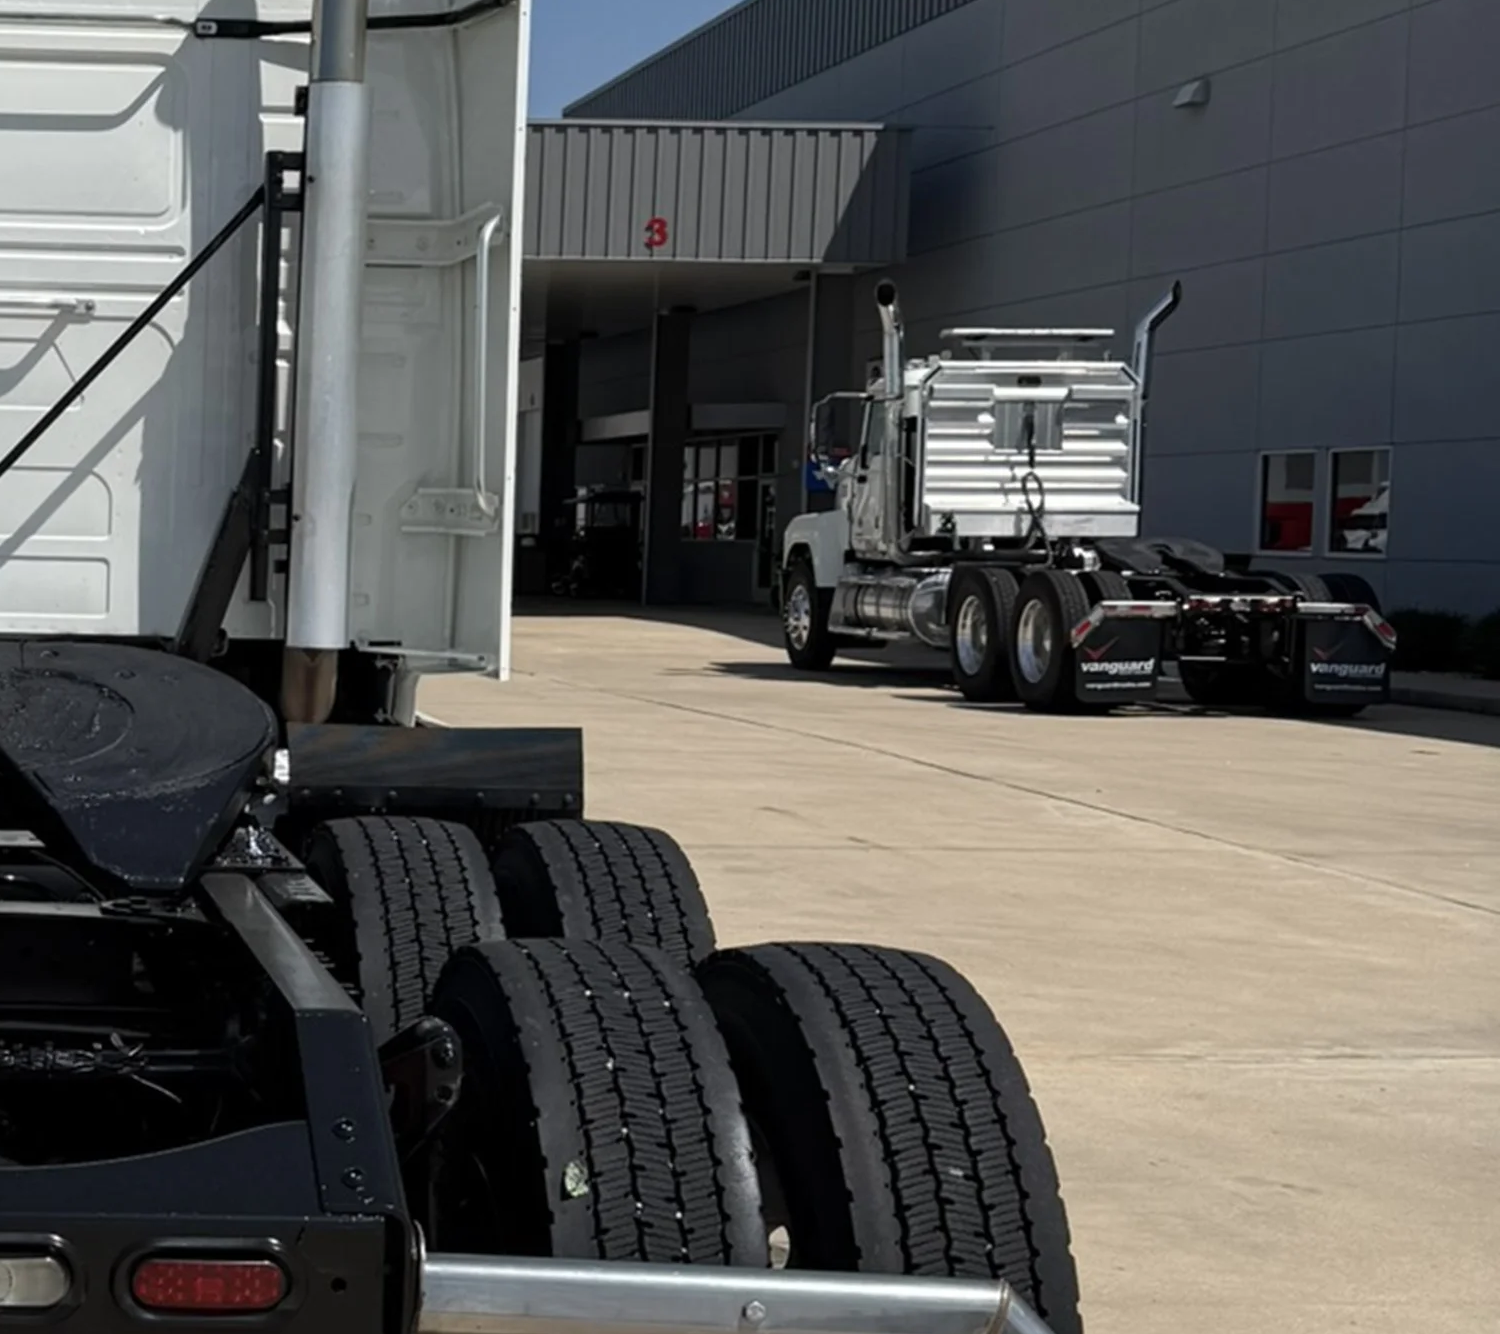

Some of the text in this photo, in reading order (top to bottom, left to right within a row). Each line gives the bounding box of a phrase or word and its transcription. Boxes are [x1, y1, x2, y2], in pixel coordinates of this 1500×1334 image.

[644, 216, 668, 249] 3
[1081, 658, 1154, 675] vanguard
[1310, 662, 1385, 677] vanguard
